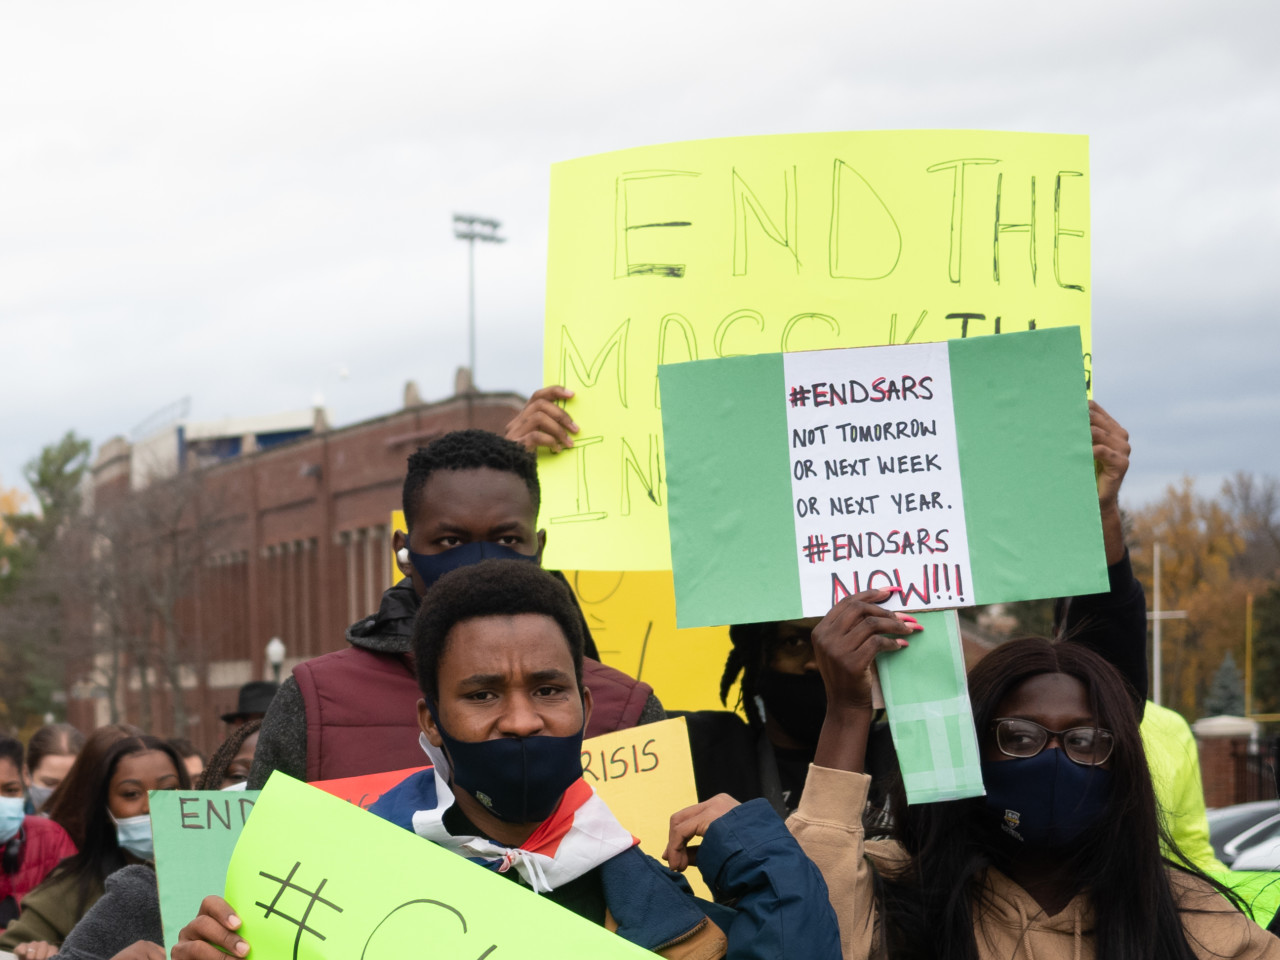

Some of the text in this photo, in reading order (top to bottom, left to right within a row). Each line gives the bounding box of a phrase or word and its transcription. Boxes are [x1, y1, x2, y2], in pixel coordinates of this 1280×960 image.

[613, 156, 1086, 293] END THE
[789, 374, 934, 408] #ENDSARS
[792, 418, 937, 448] NOT TOMORROW
[793, 453, 942, 480] OR NEXT WEEK
[796, 491, 953, 518] OR NEXT YEAR.
[802, 527, 950, 563] #ENDSARS
[831, 562, 966, 606] NOW!!!
